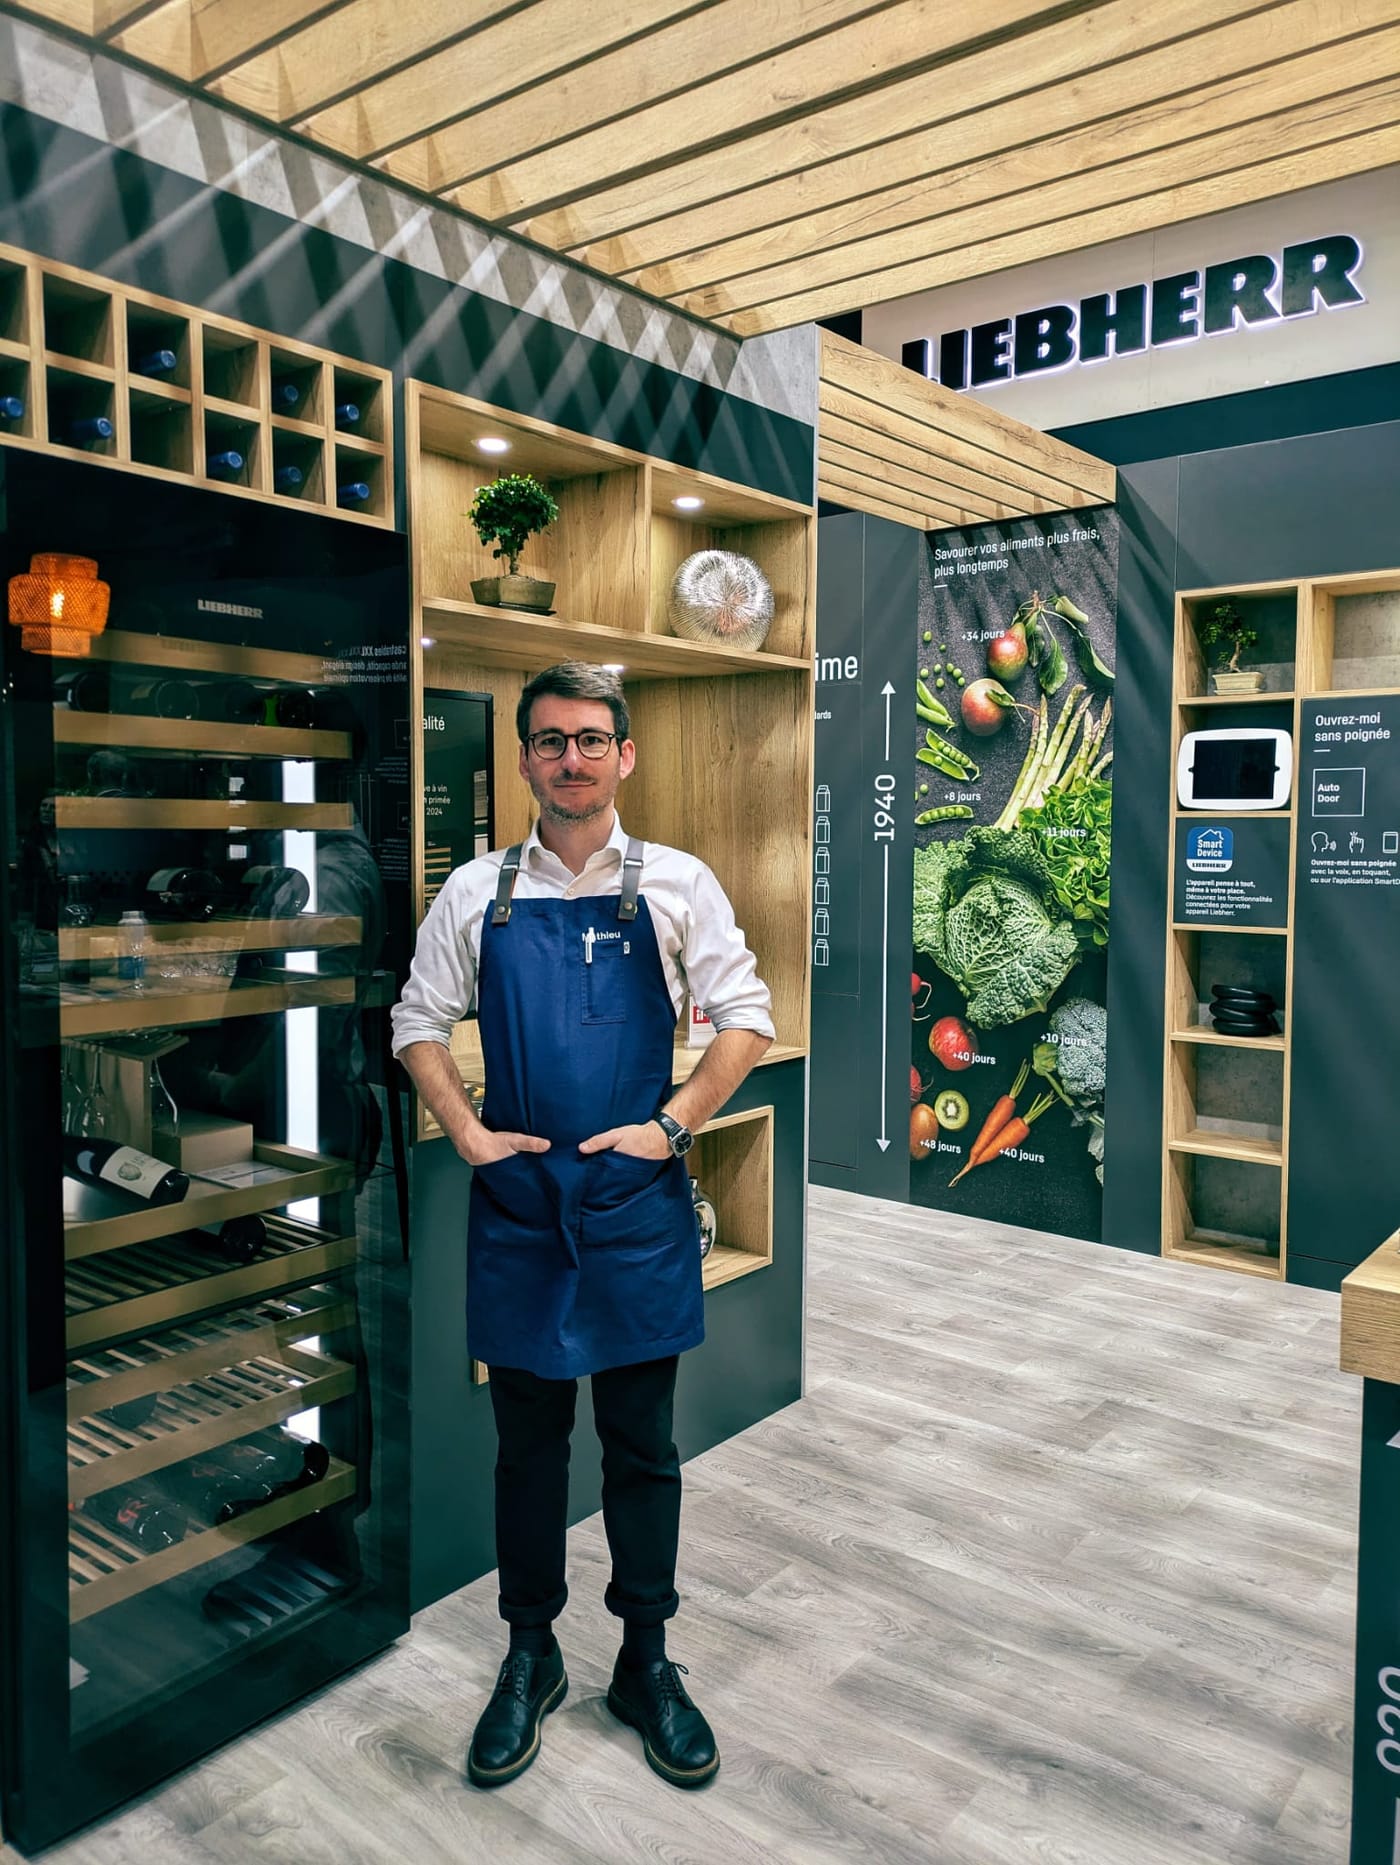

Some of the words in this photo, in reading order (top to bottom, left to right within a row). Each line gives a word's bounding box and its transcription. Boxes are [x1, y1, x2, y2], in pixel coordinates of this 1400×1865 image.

[902, 235, 1366, 391] LIEBHERR
[934, 545, 978, 561] Savourer
[980, 543, 997, 554] vos
[1000, 535, 1044, 551] aliments
[1047, 532, 1069, 547] plus
[1072, 527, 1100, 541] frais,
[934, 564, 954, 579] plus
[956, 558, 1008, 575] longtemps
[197, 599, 264, 620] LIEBHERR
[961, 631, 979, 642] +34
[980, 629, 1005, 642] jours
[815, 652, 858, 681] ime
[1315, 712, 1380, 726] Ouvrez-moi
[1315, 731, 1341, 741] sans
[1344, 728, 1390, 743] poignée
[1317, 784, 1340, 792] Auto
[944, 792, 955, 801] +8
[957, 792, 981, 803] jours
[1317, 794, 1340, 803] Door
[426, 807, 442, 816] 2024
[874, 774, 896, 841] 1940
[1060, 828, 1086, 838] jours
[1197, 839, 1222, 849] Smart
[1197, 848, 1222, 857] Device
[582, 930, 621, 942] Mthieu
[1040, 1033, 1058, 1043] +10
[1060, 1034, 1088, 1046] jours
[952, 1052, 970, 1062] +40
[971, 1053, 996, 1065] jours
[920, 1140, 936, 1150] +48
[938, 1141, 961, 1154] jours
[999, 1148, 1017, 1158] +40
[1019, 1149, 1045, 1163] jours
